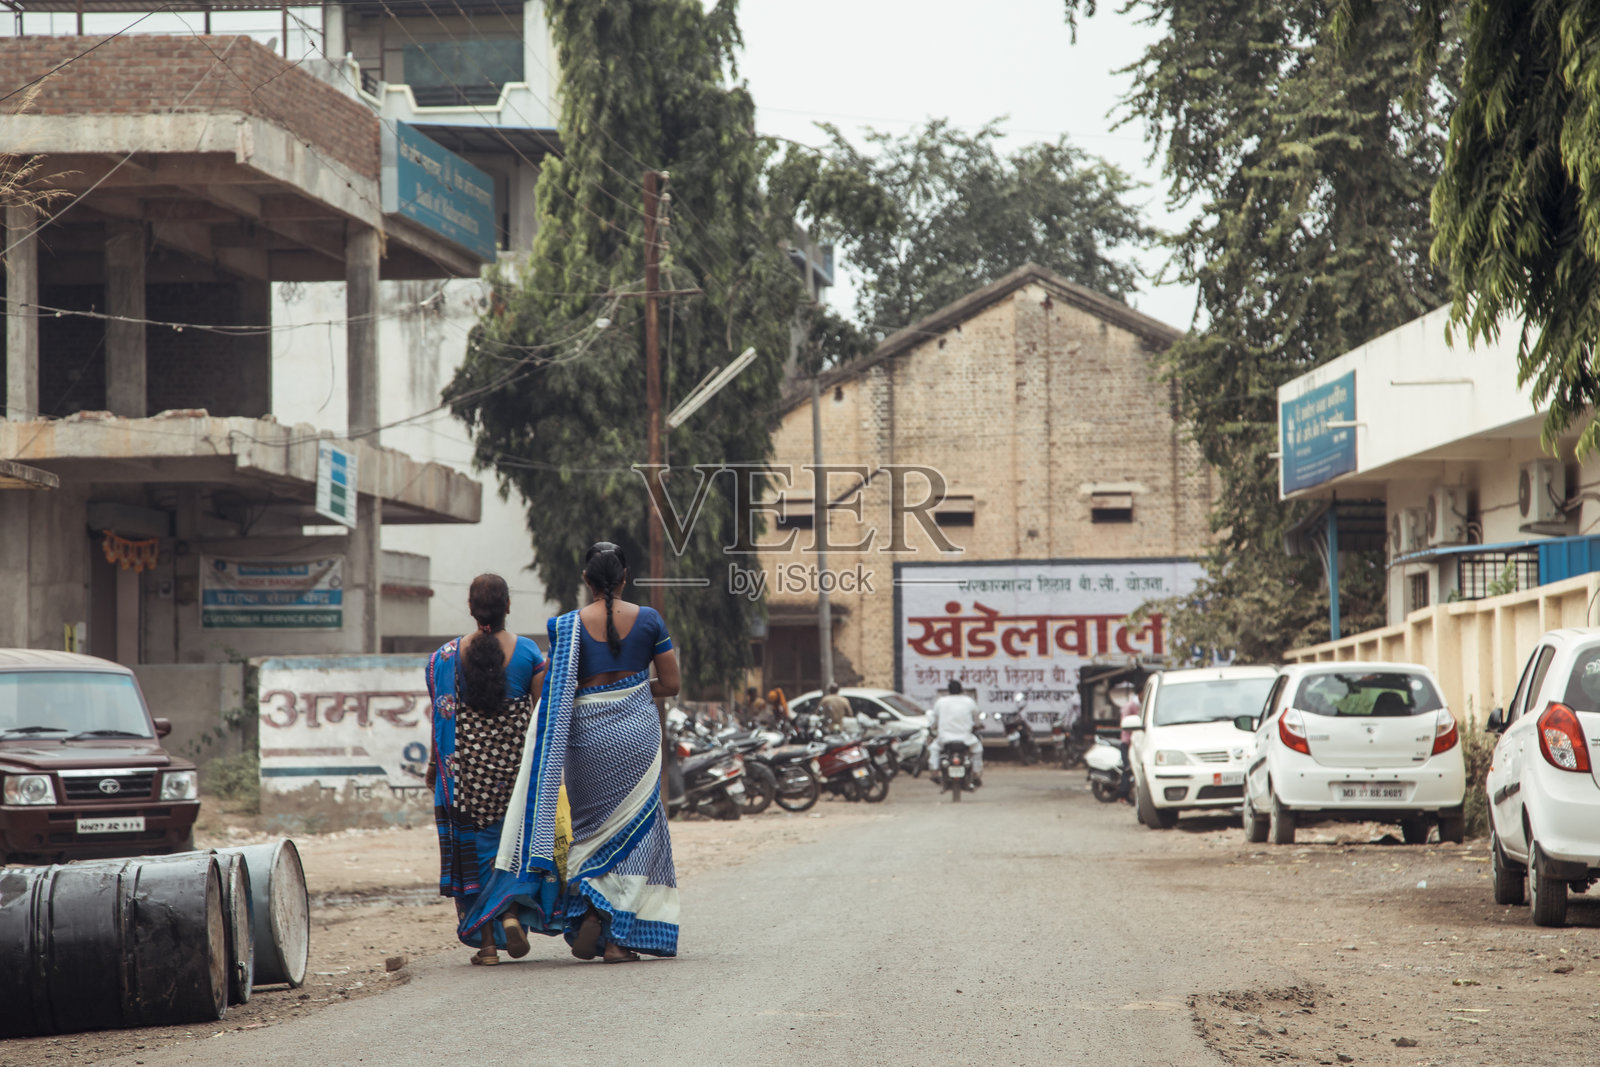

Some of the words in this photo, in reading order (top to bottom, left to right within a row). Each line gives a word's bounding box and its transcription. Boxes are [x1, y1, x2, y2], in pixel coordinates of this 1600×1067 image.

[203, 614, 260, 625] CUSTOMER
[263, 614, 305, 625] SERVICE
[308, 614, 339, 625] POINT
[907, 600, 1165, 659] खंडेलवाल
[260, 689, 434, 728] अमर
